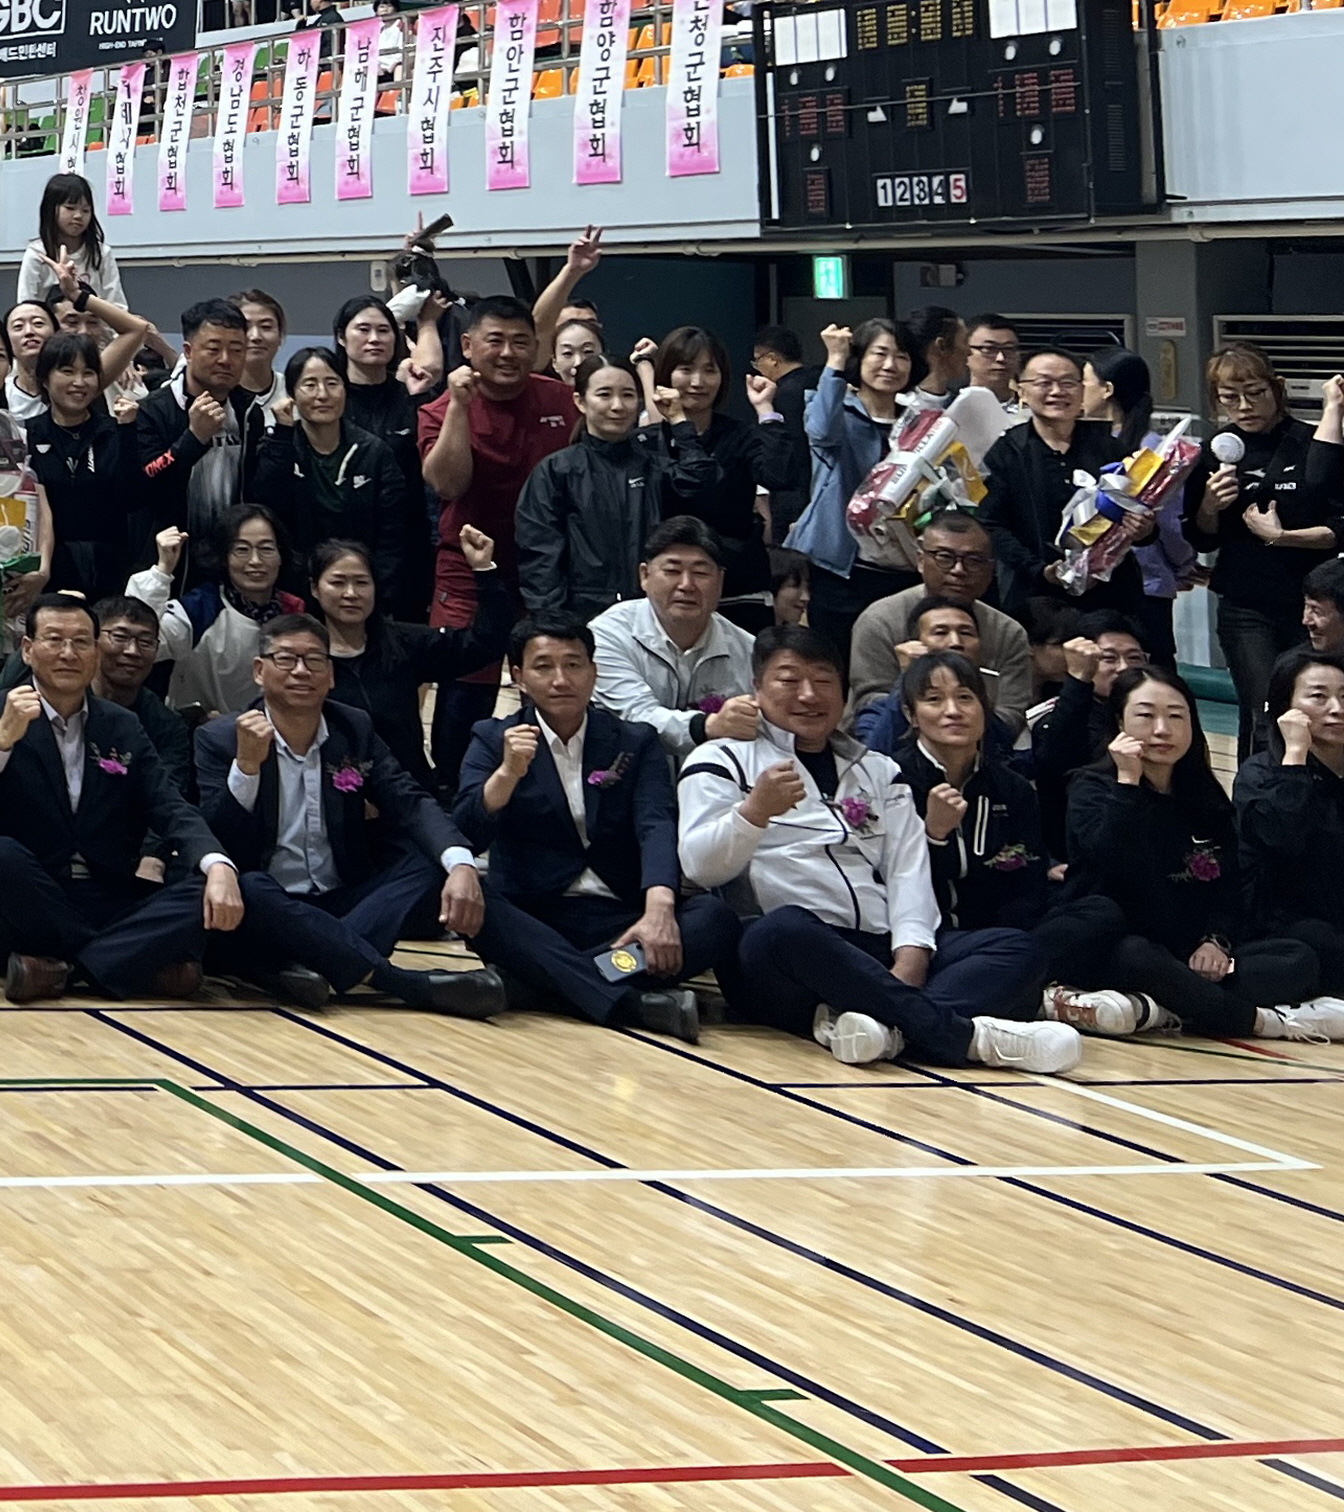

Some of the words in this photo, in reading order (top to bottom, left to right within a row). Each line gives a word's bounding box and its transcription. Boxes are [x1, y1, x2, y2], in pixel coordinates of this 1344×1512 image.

[89, 3, 177, 35] RUNTWO
[67, 85, 87, 175] 창원시협
[165, 68, 190, 194] 합천군협회
[221, 58, 245, 191] 경남도협회
[286, 48, 311, 185] 하동군협회
[346, 37, 372, 180] 남해군협회
[419, 25, 446, 175] 진주시협회
[497, 12, 527, 169] 함안군협회
[144, 449, 175, 478] ONEX
